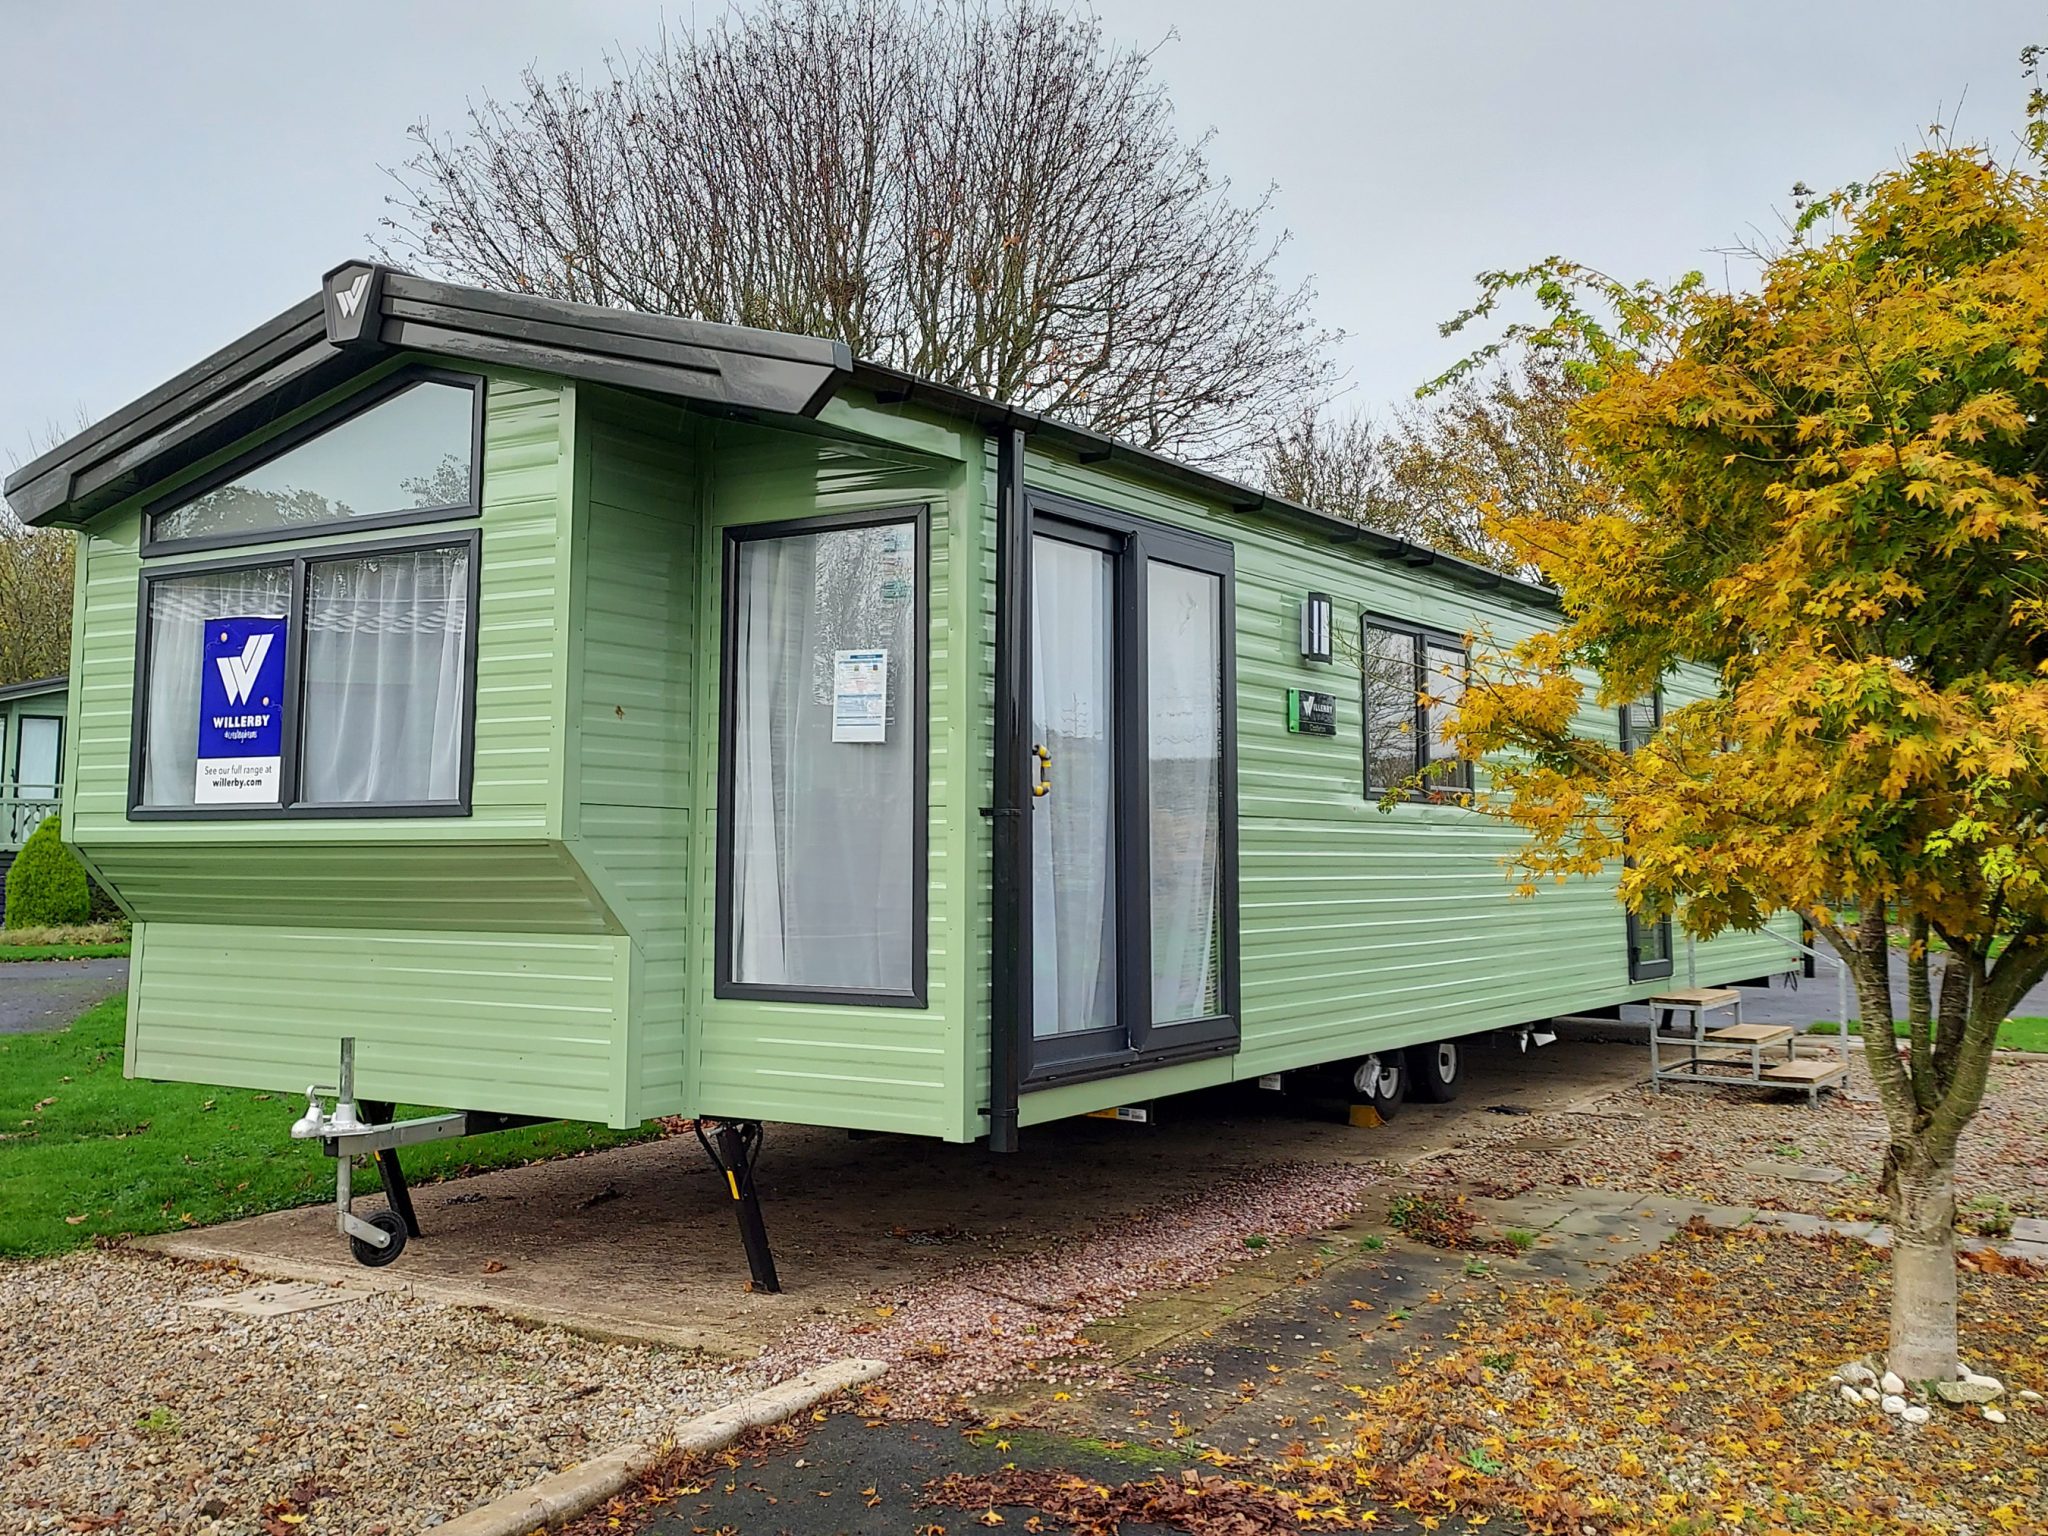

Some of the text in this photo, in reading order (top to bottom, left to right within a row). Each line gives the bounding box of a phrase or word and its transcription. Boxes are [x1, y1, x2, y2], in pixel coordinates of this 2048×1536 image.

[213, 714, 270, 729] WILLERBY
[204, 764, 272, 776] See our full range at
[212, 777, 262, 789] willerby.com
